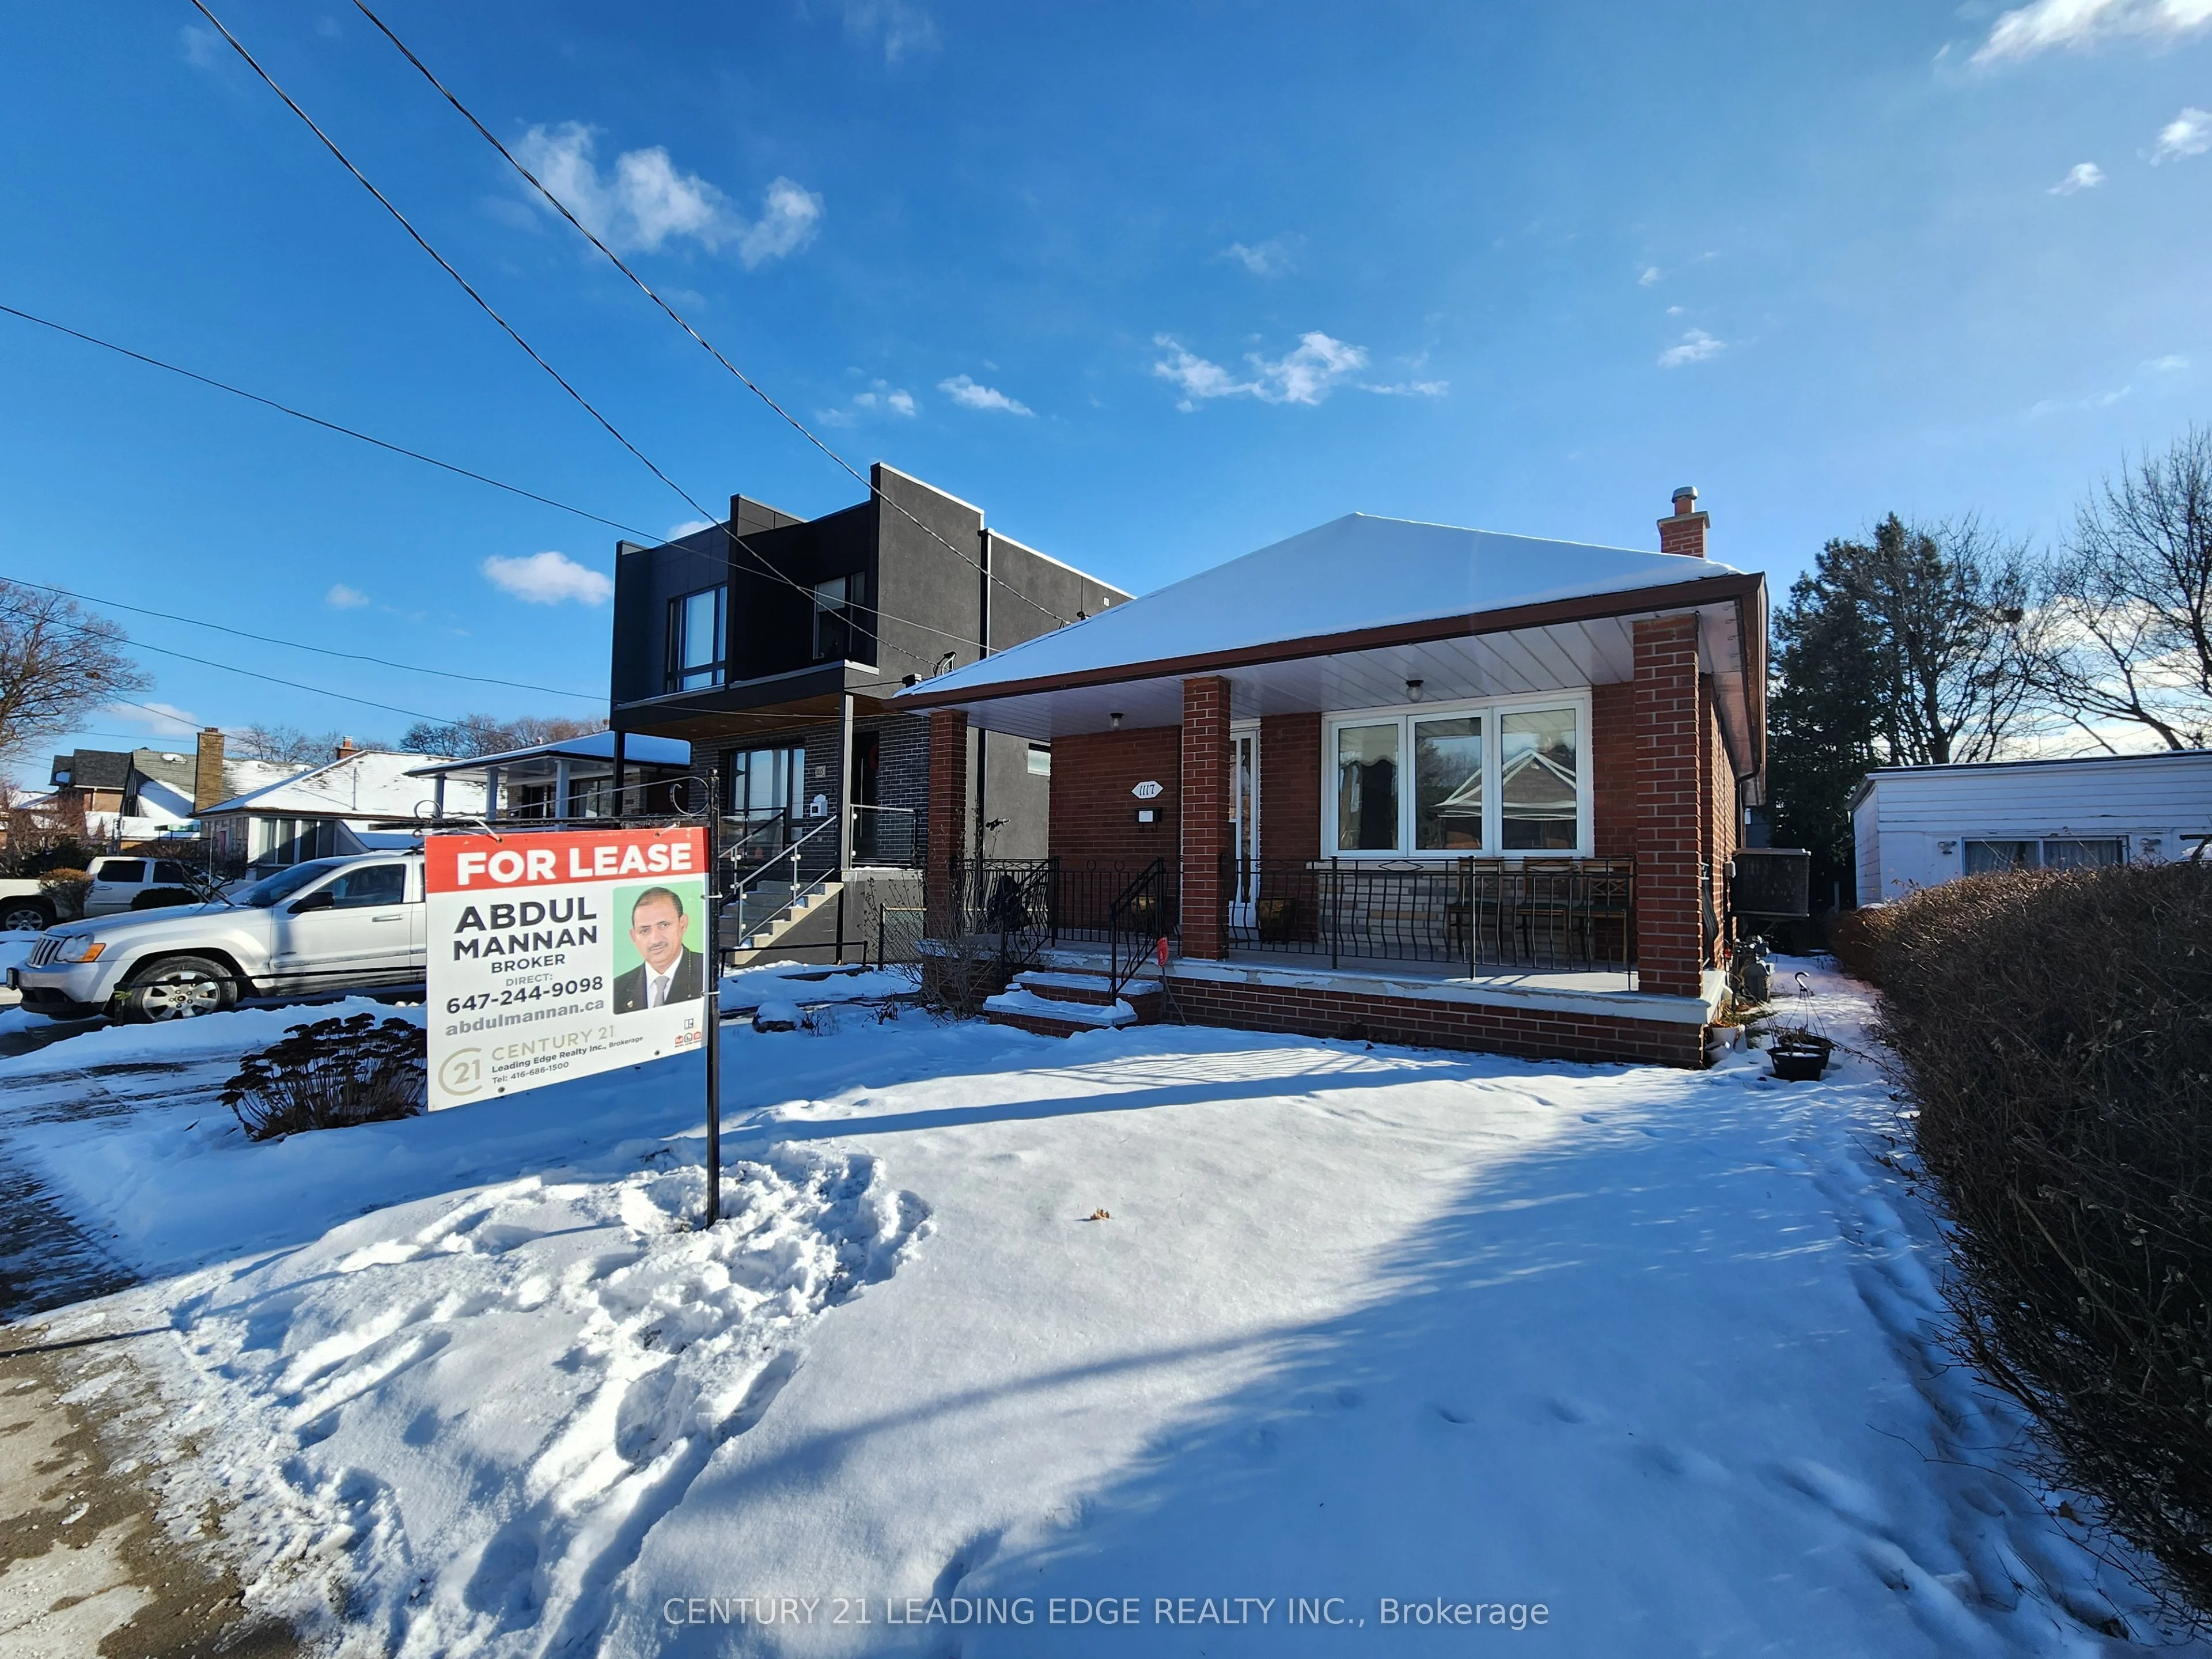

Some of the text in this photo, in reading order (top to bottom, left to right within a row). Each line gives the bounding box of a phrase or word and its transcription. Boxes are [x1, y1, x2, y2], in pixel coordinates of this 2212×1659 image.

[1139, 784, 1155, 796] 1117
[457, 842, 691, 885] FOR LEASE
[454, 897, 597, 934] ABDUL
[453, 925, 597, 961] MANNAN
[491, 954, 566, 974] BROKER
[506, 973, 554, 987] DIRECT:
[446, 976, 603, 1014] 647-244-9098
[445, 999, 604, 1036] abdulmannan.ca
[491, 1025, 614, 1061] CENTURY 21
[491, 1059, 531, 1073] Leading
[533, 1054, 557, 1066] Edge
[559, 1048, 588, 1059] Realty
[609, 1036, 643, 1048] Brokerage
[491, 1062, 569, 1084] Tel: 416-686-1500
